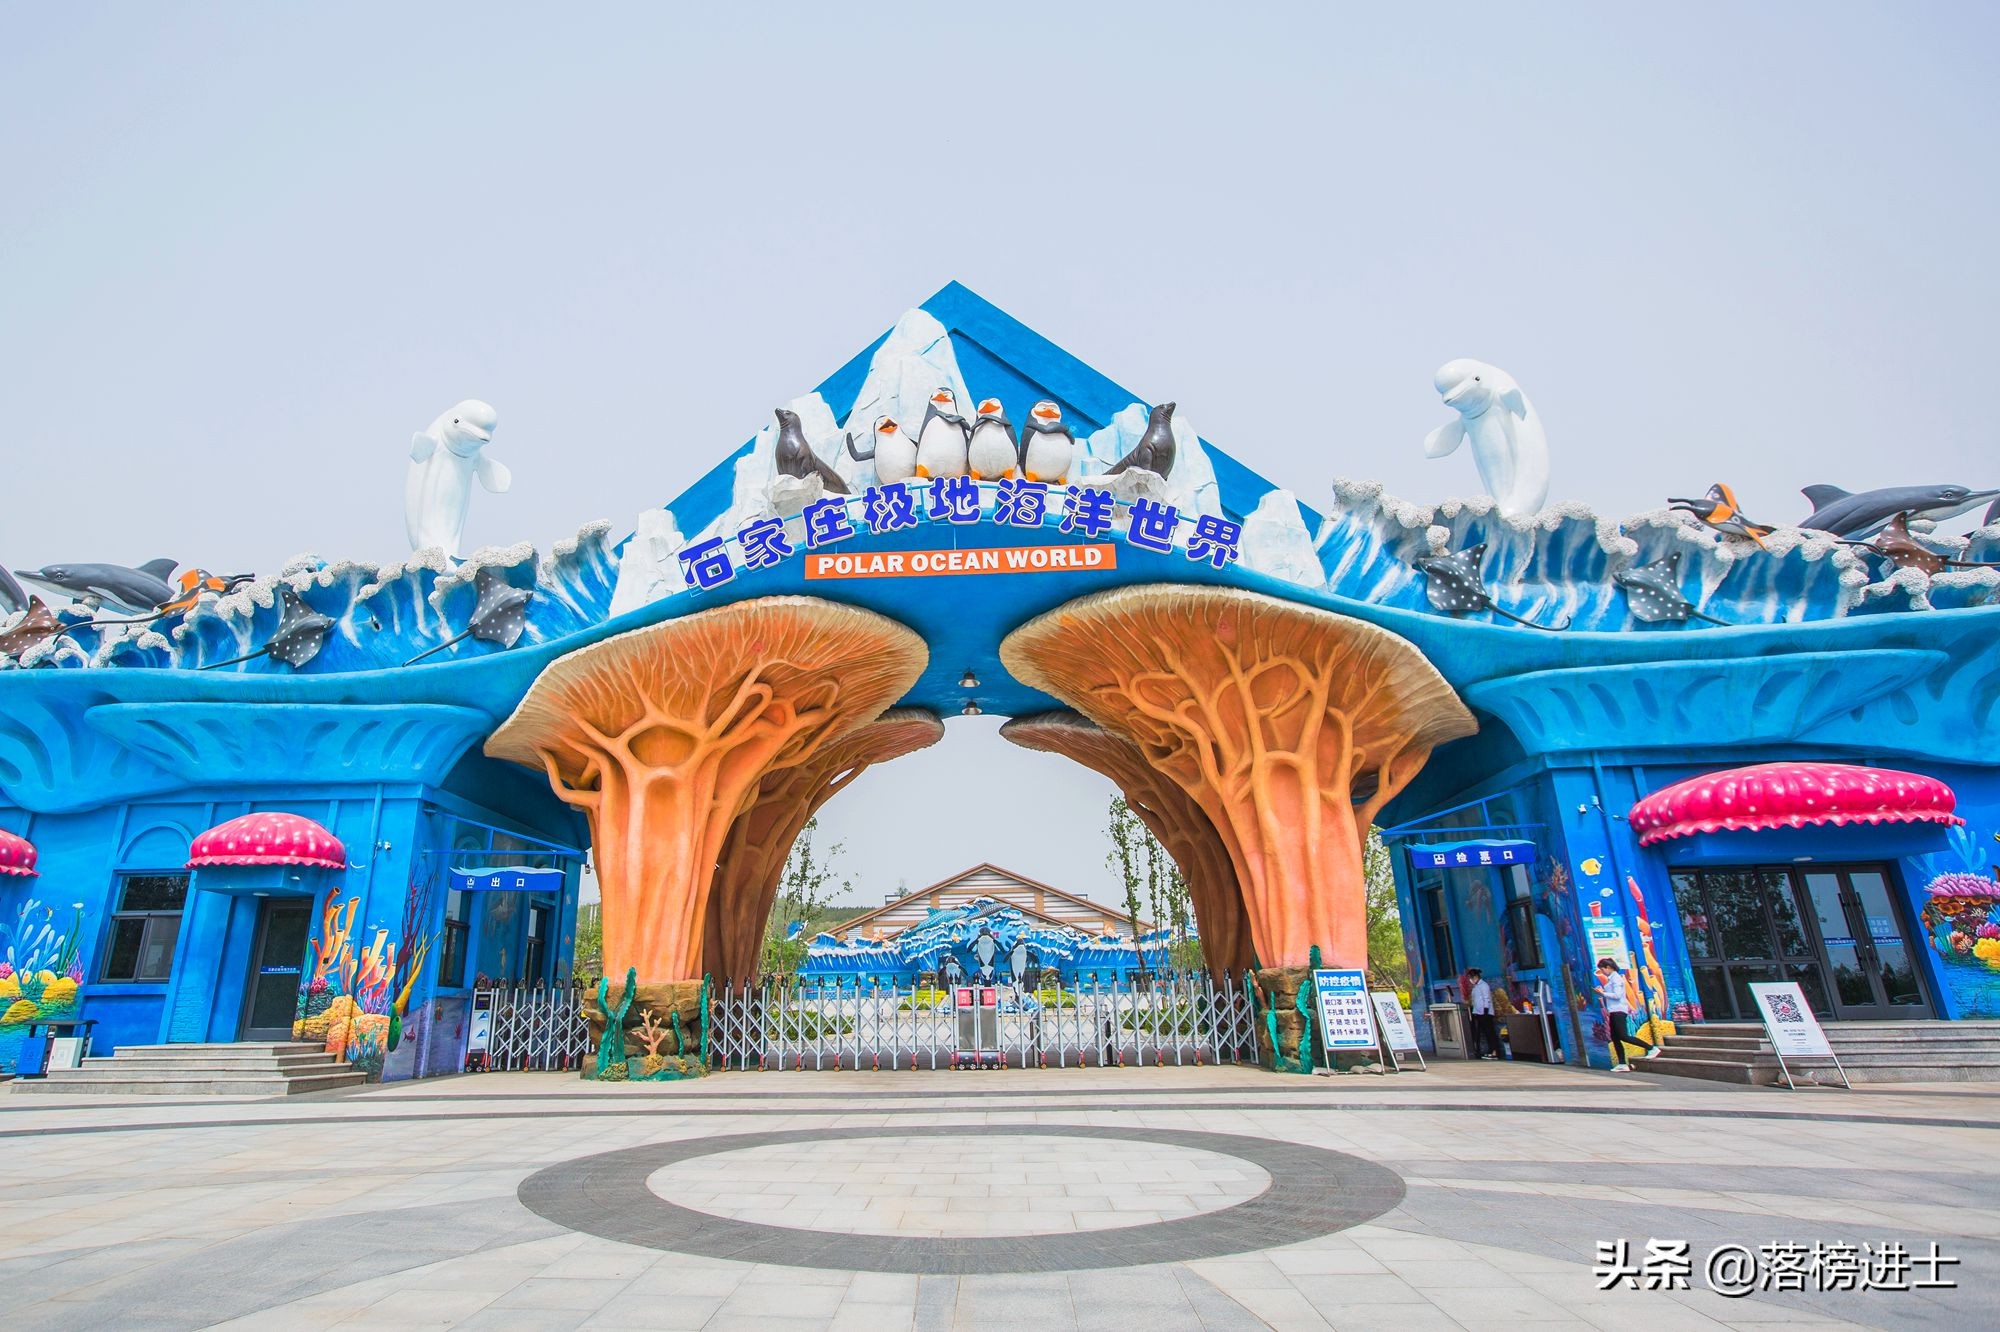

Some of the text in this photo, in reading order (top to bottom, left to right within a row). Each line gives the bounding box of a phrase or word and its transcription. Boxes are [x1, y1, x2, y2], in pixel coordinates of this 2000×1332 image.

[678, 475, 1243, 592] 石家庄极地海洋世界
[817, 547, 1103, 576] POLAR OCEAN WORLD
[1455, 850, 1513, 865] 检票口
[491, 876, 525, 888] 出口
